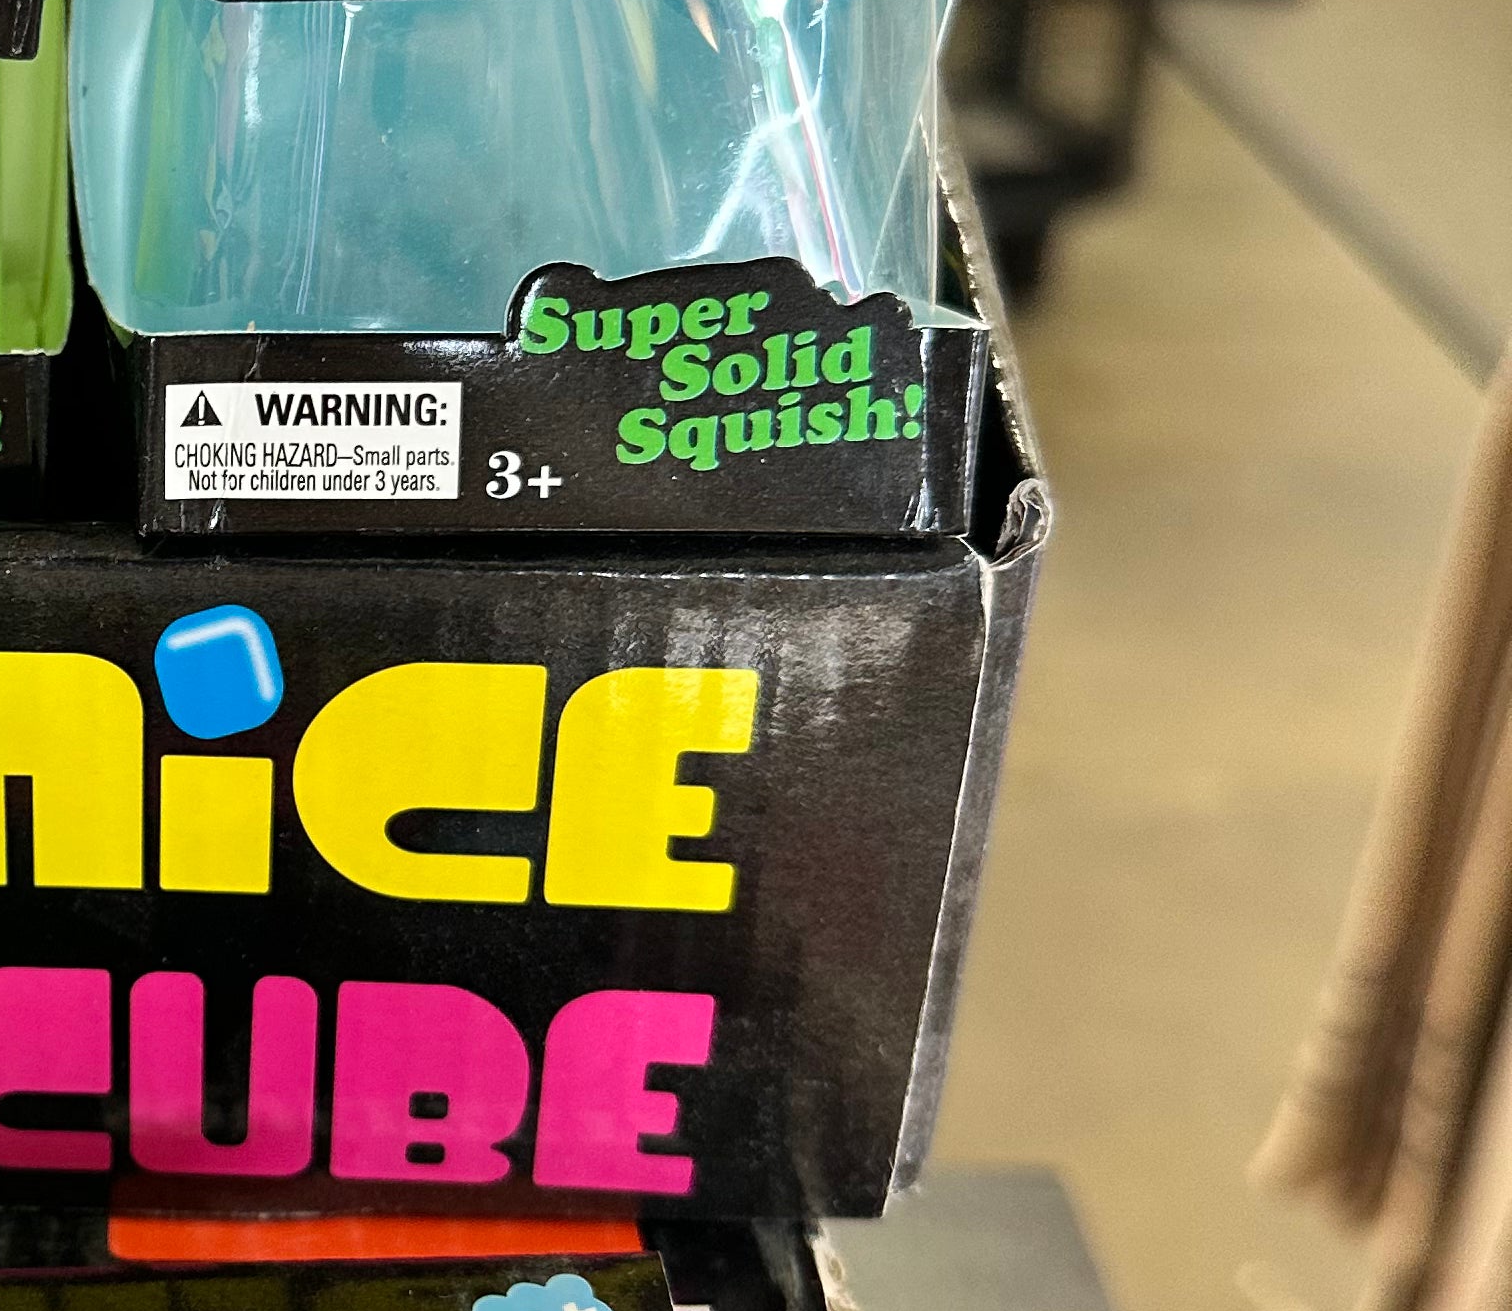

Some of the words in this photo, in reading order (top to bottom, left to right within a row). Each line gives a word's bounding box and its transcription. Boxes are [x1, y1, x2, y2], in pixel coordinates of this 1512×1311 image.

[517, 288, 773, 364] Super
[658, 325, 874, 404] Solid
[254, 392, 448, 428] WARNING:
[614, 382, 926, 472] Squish!
[174, 442, 257, 468] CHOKING
[405, 445, 455, 469] parts.
[484, 449, 563, 501] 3+
[188, 469, 218, 492] Not
[221, 468, 243, 492] for
[250, 468, 317, 492] children
[322, 468, 372, 492] under
[374, 469, 386, 492] 3
[390, 470, 441, 496] years.
